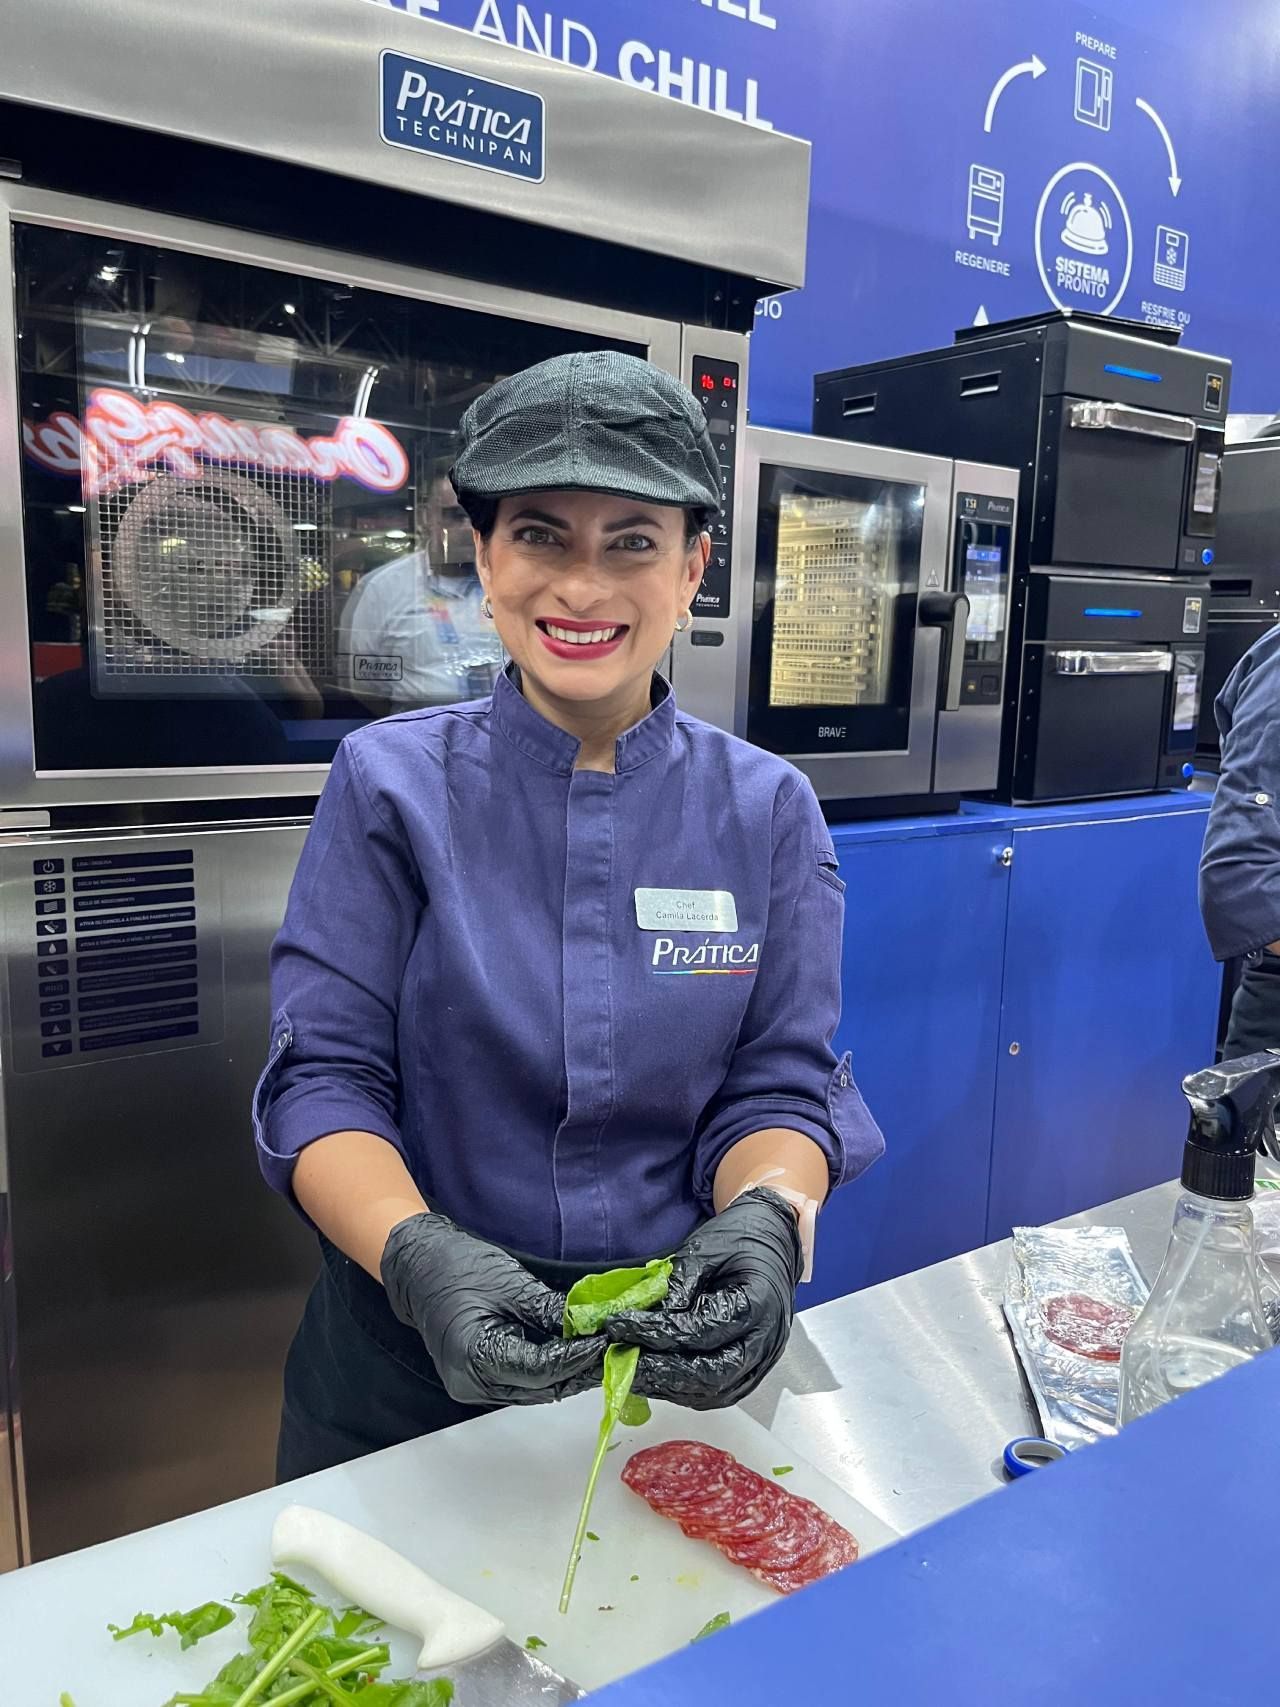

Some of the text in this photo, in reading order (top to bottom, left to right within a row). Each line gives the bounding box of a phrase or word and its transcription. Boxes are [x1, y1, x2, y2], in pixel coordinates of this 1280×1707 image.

[1075, 31, 1117, 60] PREPARE
[472, 0, 774, 130] AND CHILL
[396, 116, 532, 166] TECHNIPAN
[955, 250, 1011, 277] REGENERE
[1056, 256, 1110, 285] SISTEMA
[1057, 272, 1107, 298] PRONTO
[1141, 300, 1191, 325] RESFRIE OU
[818, 726, 847, 738] BRAVE
[656, 911, 719, 921] Camila Lacerda
[676, 901, 695, 910] Chef
